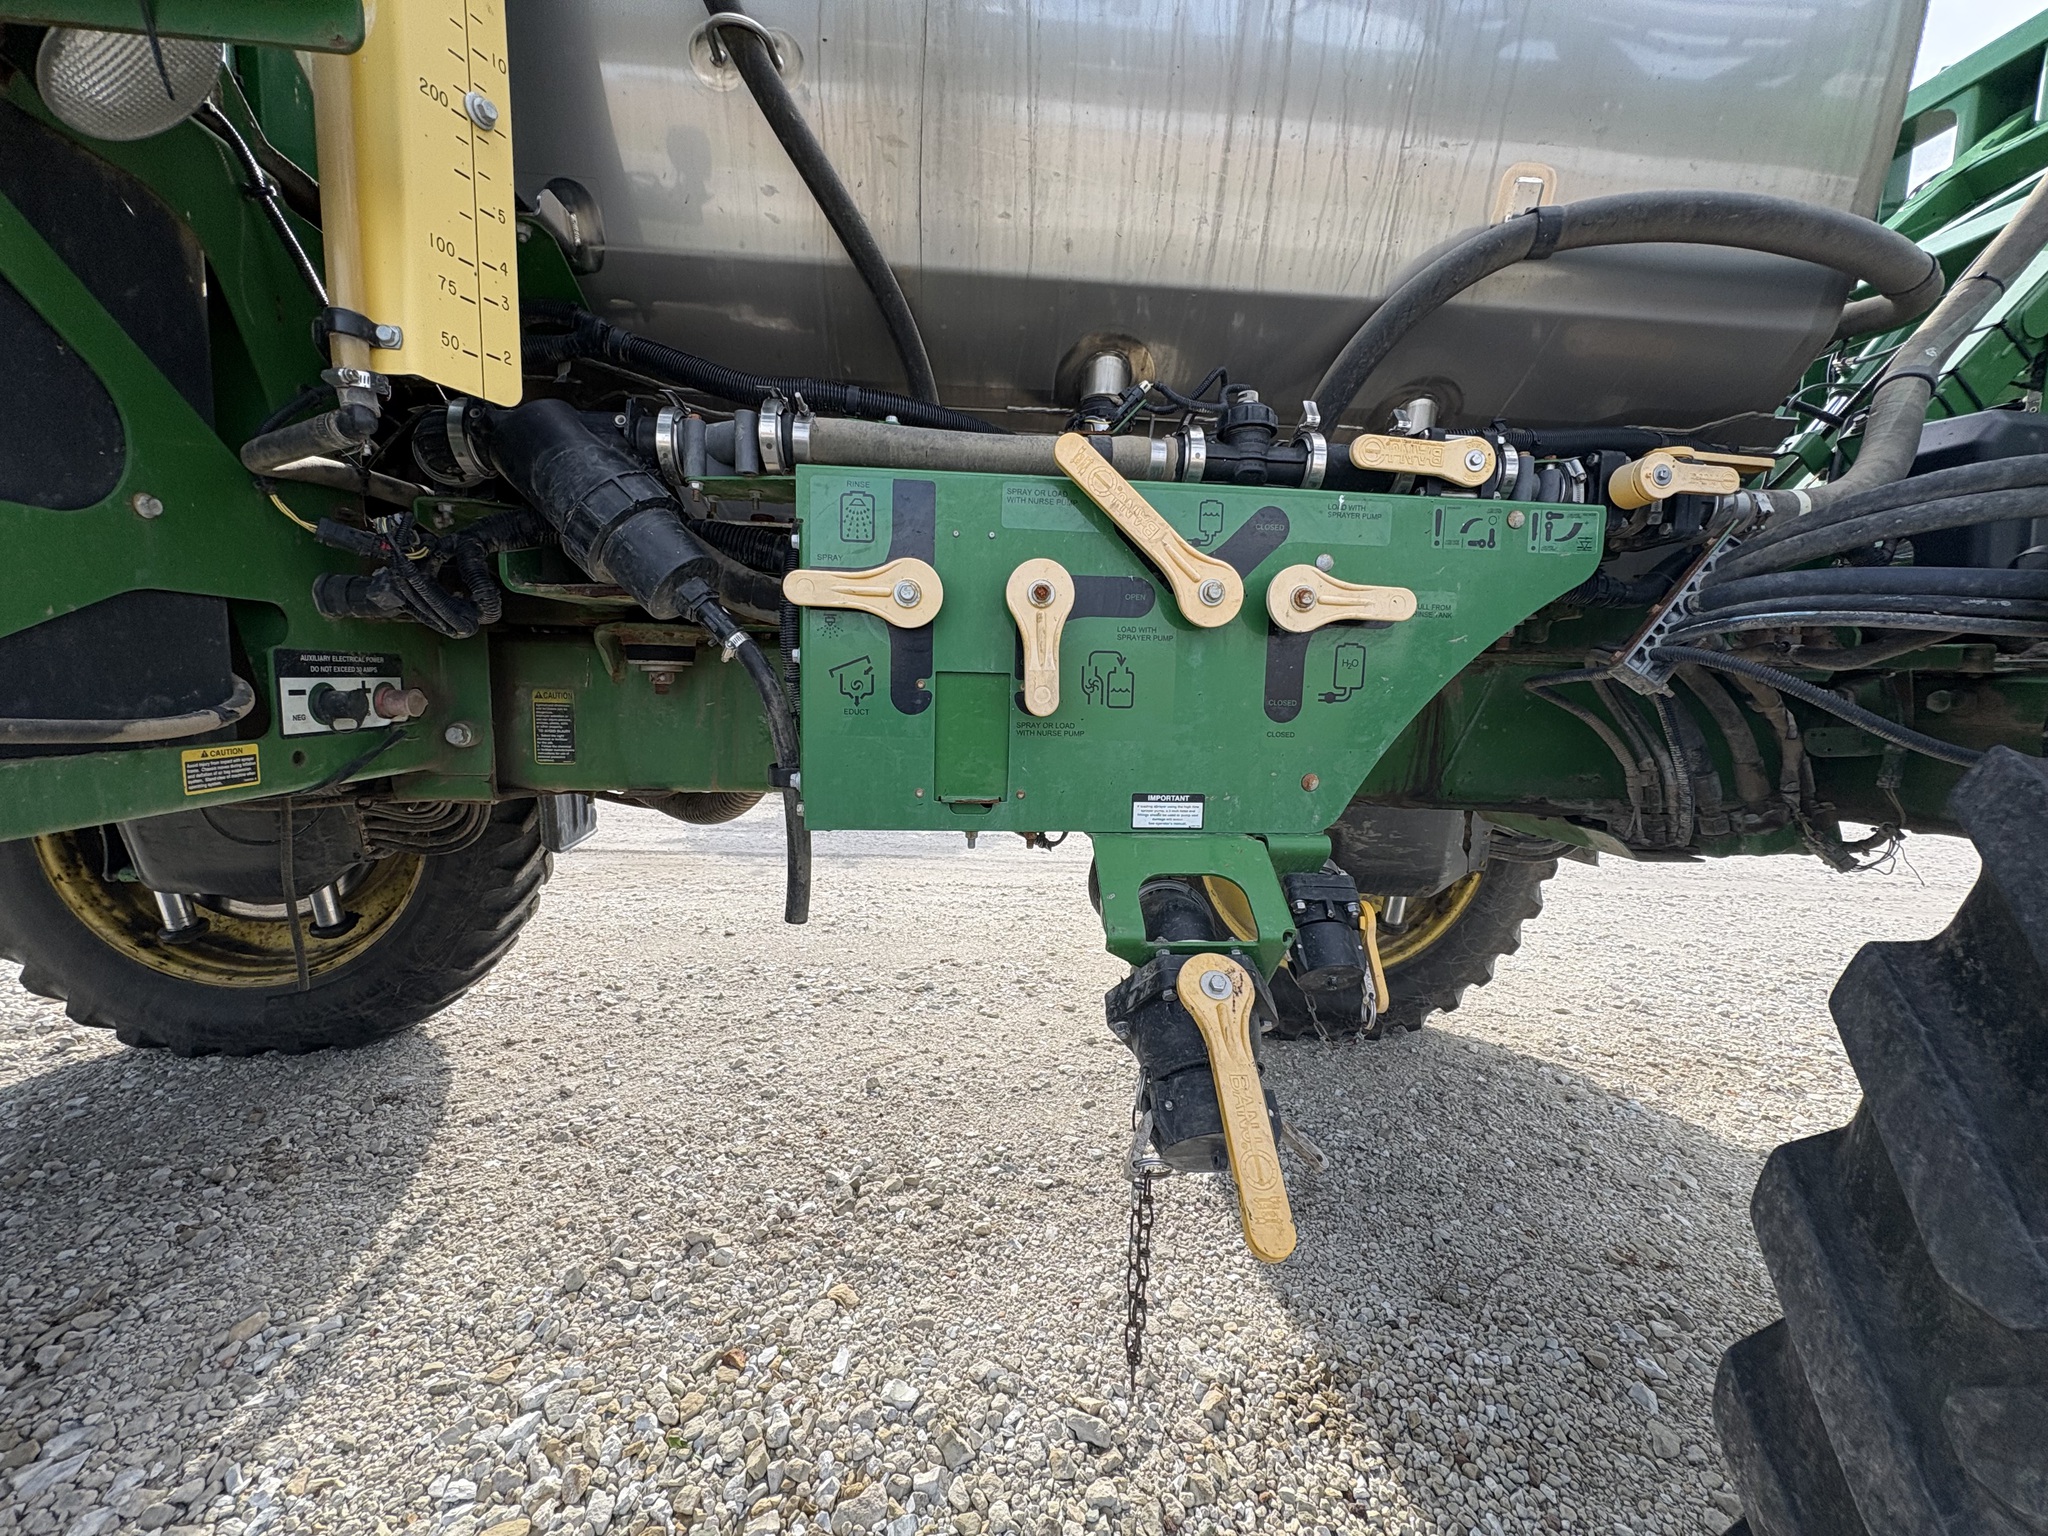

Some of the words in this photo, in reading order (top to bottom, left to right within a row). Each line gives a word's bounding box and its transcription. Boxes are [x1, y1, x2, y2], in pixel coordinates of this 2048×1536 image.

[492, 53, 507, 75] 10
[419, 77, 449, 108] 200
[497, 209, 506, 225] 5
[430, 232, 455, 258] 100
[500, 262, 509, 277] 4
[438, 274, 457, 296] 75
[501, 295, 510, 312] 3
[441, 331, 460, 351] 50
[503, 351, 512, 366] 2
[846, 480, 870, 488] RINSE
[1006, 488, 1033, 496] SPRAY
[1034, 489, 1046, 497] OR
[1047, 490, 1069, 498] LOAD
[1006, 496, 1026, 504] WITH
[1027, 497, 1055, 506] NURSE
[1327, 503, 1347, 511] LOAD
[1348, 504, 1366, 512] WITH
[1327, 511, 1360, 519] SPRAYER
[1361, 512, 1383, 520] PUMP
[1255, 523, 1285, 532] CLOSED
[817, 553, 843, 561] SPRAY
[1124, 593, 1147, 601] OPEN
[1417, 603, 1429, 611] ULL
[1431, 603, 1452, 611] FROM
[1116, 625, 1137, 634] LOAD
[1138, 626, 1157, 634] WITH
[1116, 633, 1152, 641] SPRAYER
[1153, 634, 1174, 642] PUMP
[300, 654, 331, 662] AUXILIARY
[332, 655, 365, 663] ELECTRICAL
[365, 656, 384, 664] POWER
[310, 665, 319, 673] DO
[320, 665, 333, 673] NOT
[333, 665, 355, 673] EXCEED
[363, 666, 378, 674] AMPS
[543, 691, 573, 700] CAUTION
[1268, 699, 1298, 707] CLOSED
[843, 708, 870, 716] EDUCT
[292, 714, 307, 722] NEG
[1016, 722, 1041, 730] SPRAY
[1042, 722, 1054, 730] OR
[1055, 722, 1076, 730] LOAD
[1016, 729, 1036, 737] WITH
[1036, 729, 1062, 737] NURSE
[1266, 731, 1296, 739] CLOSED
[210, 748, 243, 757] CAUTION
